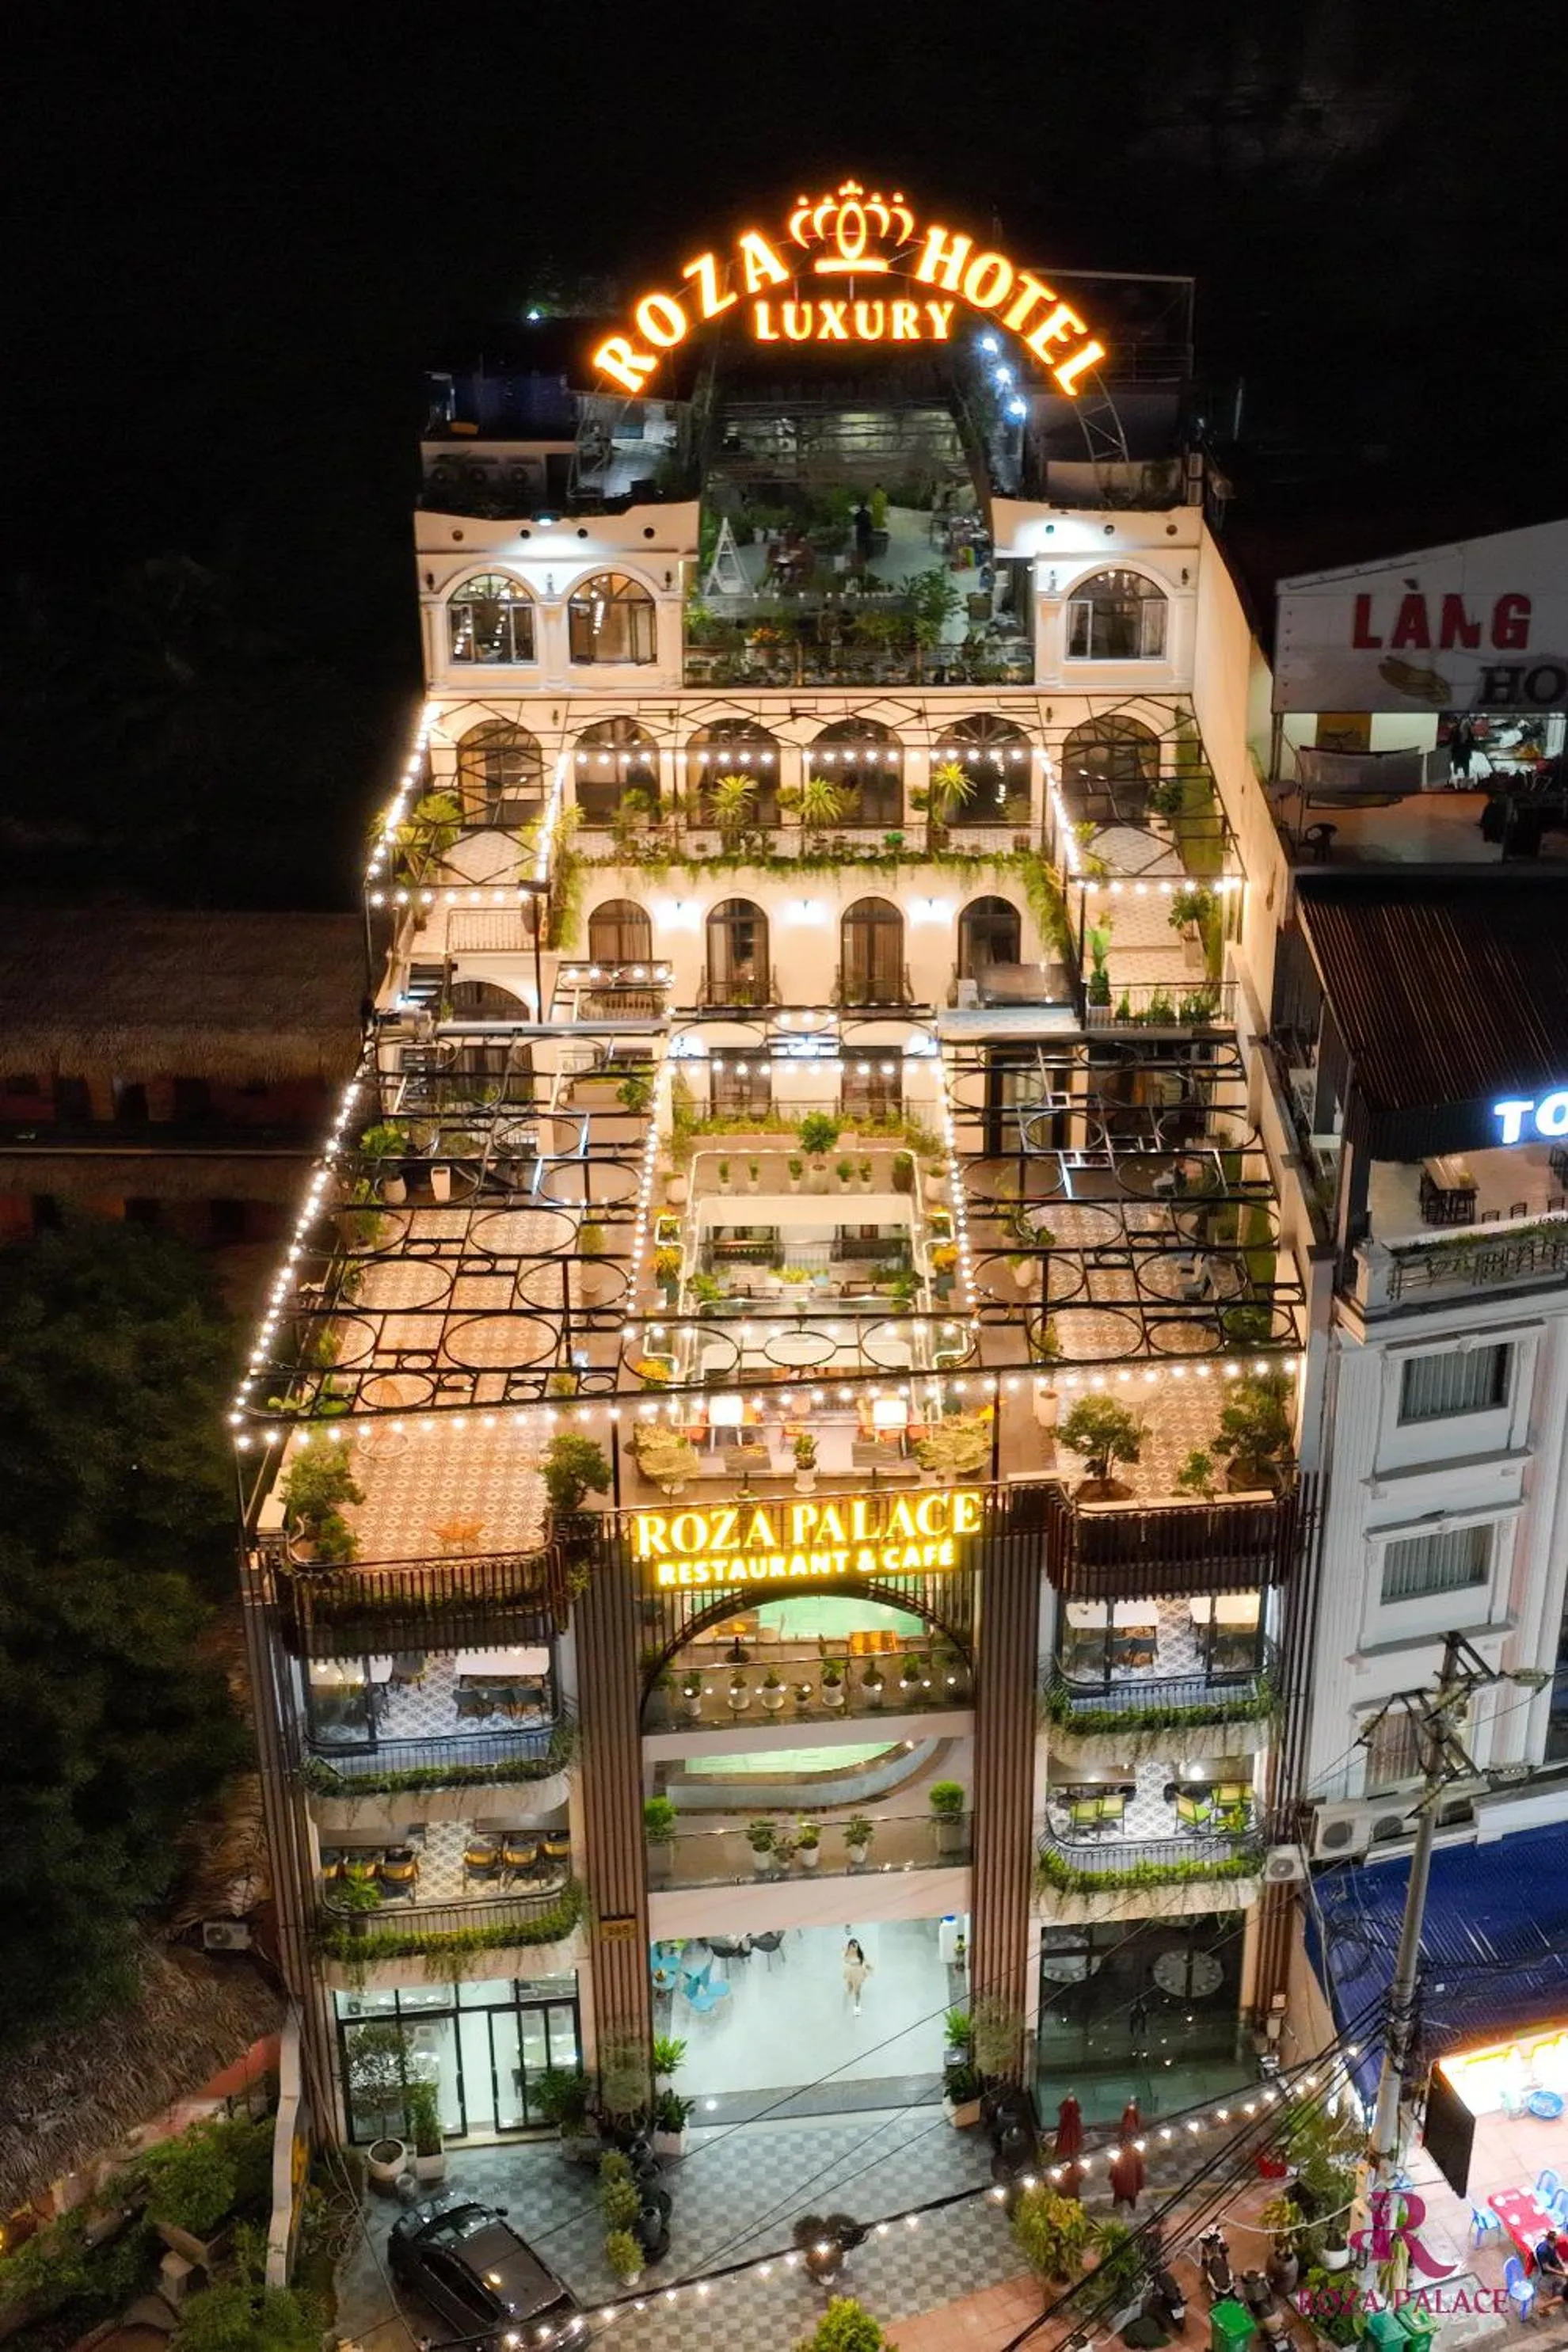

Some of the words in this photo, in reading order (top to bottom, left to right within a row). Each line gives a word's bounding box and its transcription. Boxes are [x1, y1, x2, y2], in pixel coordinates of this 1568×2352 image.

[593, 231, 790, 394] ROZA
[754, 301, 954, 341] LUXURY
[915, 226, 1106, 396] HOTEL
[1353, 578, 1532, 650] LÀNG
[637, 1509, 775, 1557] ROZA
[792, 1492, 981, 1547] PALACE
[657, 1552, 850, 1586] RESTAURANT
[857, 1551, 878, 1571] &
